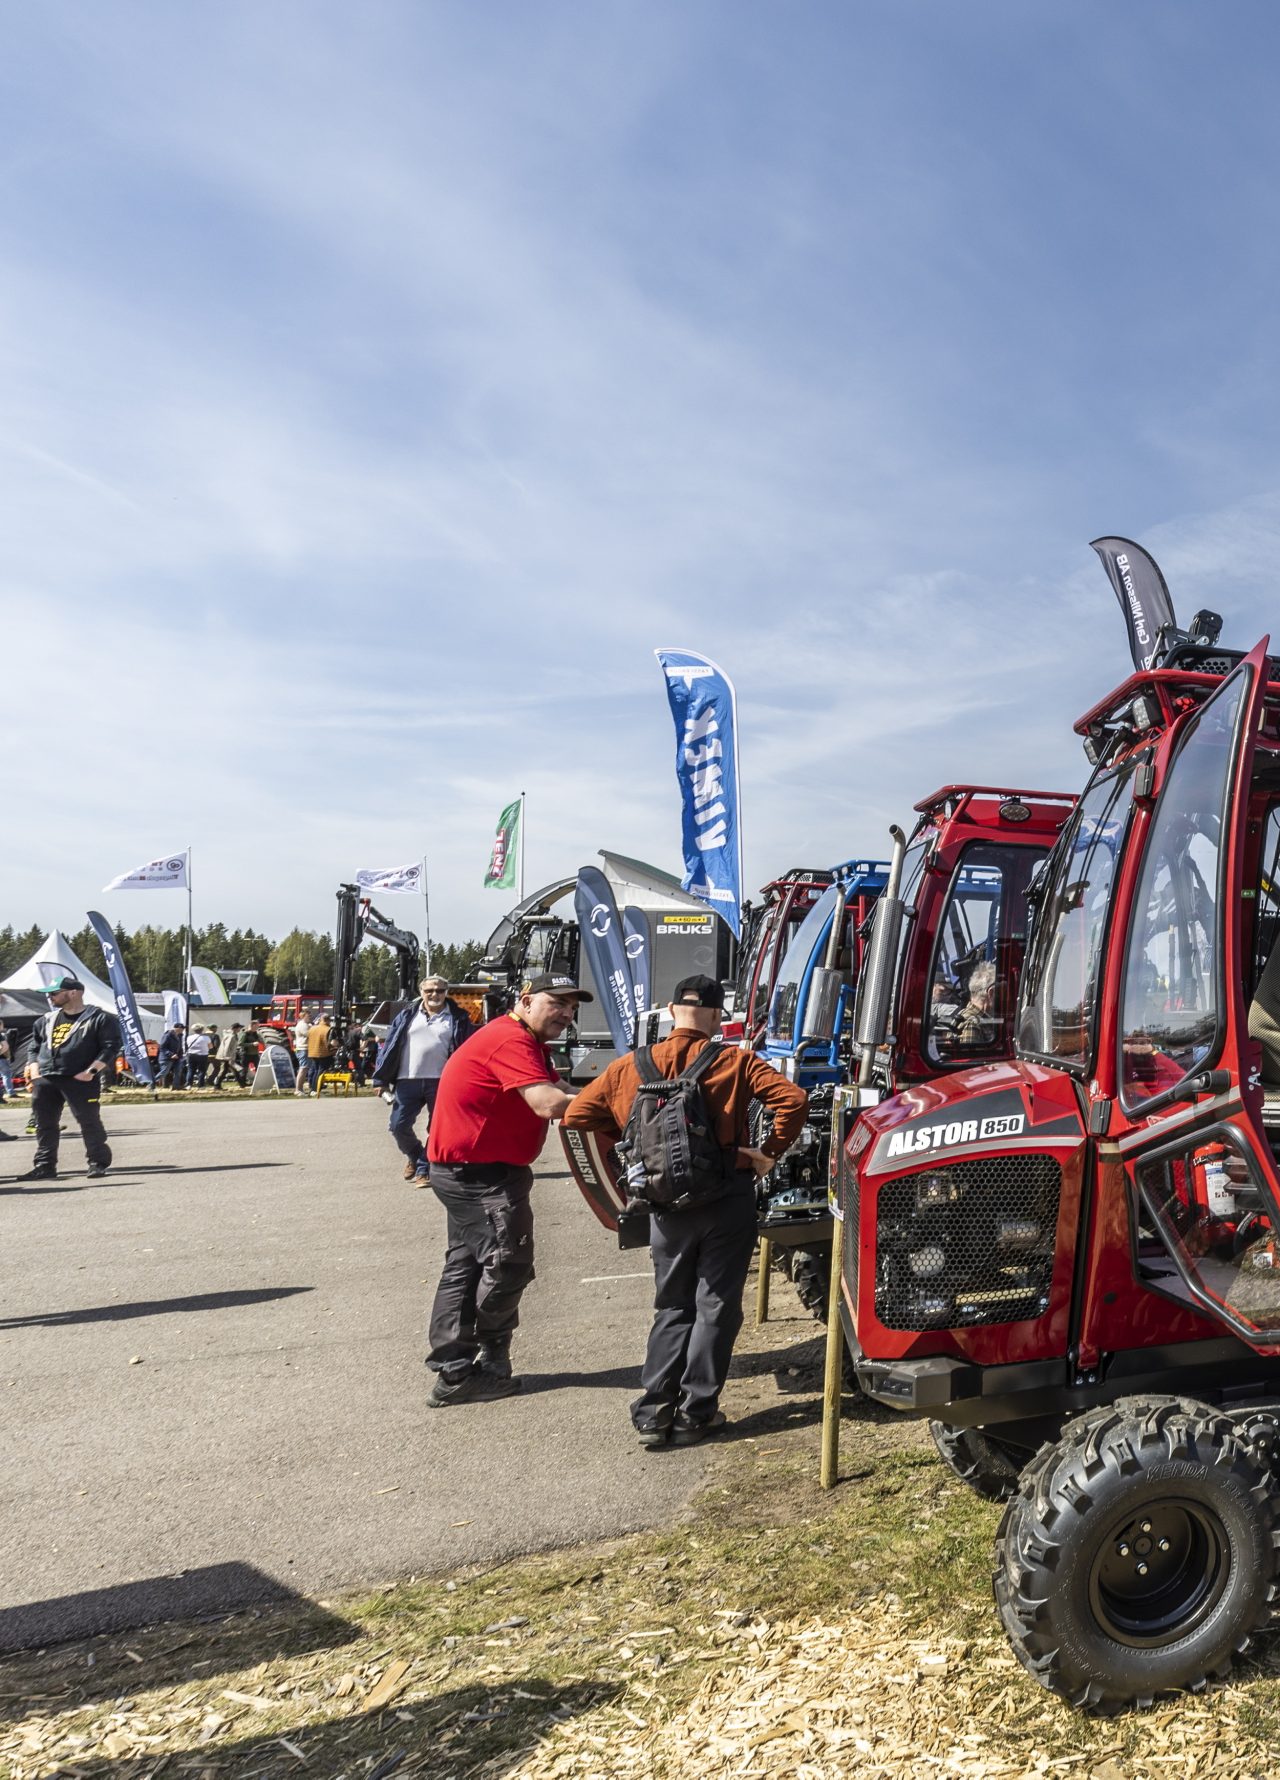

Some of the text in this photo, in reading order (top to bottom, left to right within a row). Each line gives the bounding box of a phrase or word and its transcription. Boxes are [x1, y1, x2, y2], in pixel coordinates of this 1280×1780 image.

[656, 925, 712, 935] BRUKS
[887, 1116, 1021, 1157] ALSTOR 850
[566, 1129, 598, 1186] 834 ALSTOR
[1147, 1462, 1209, 1482] KENDA
